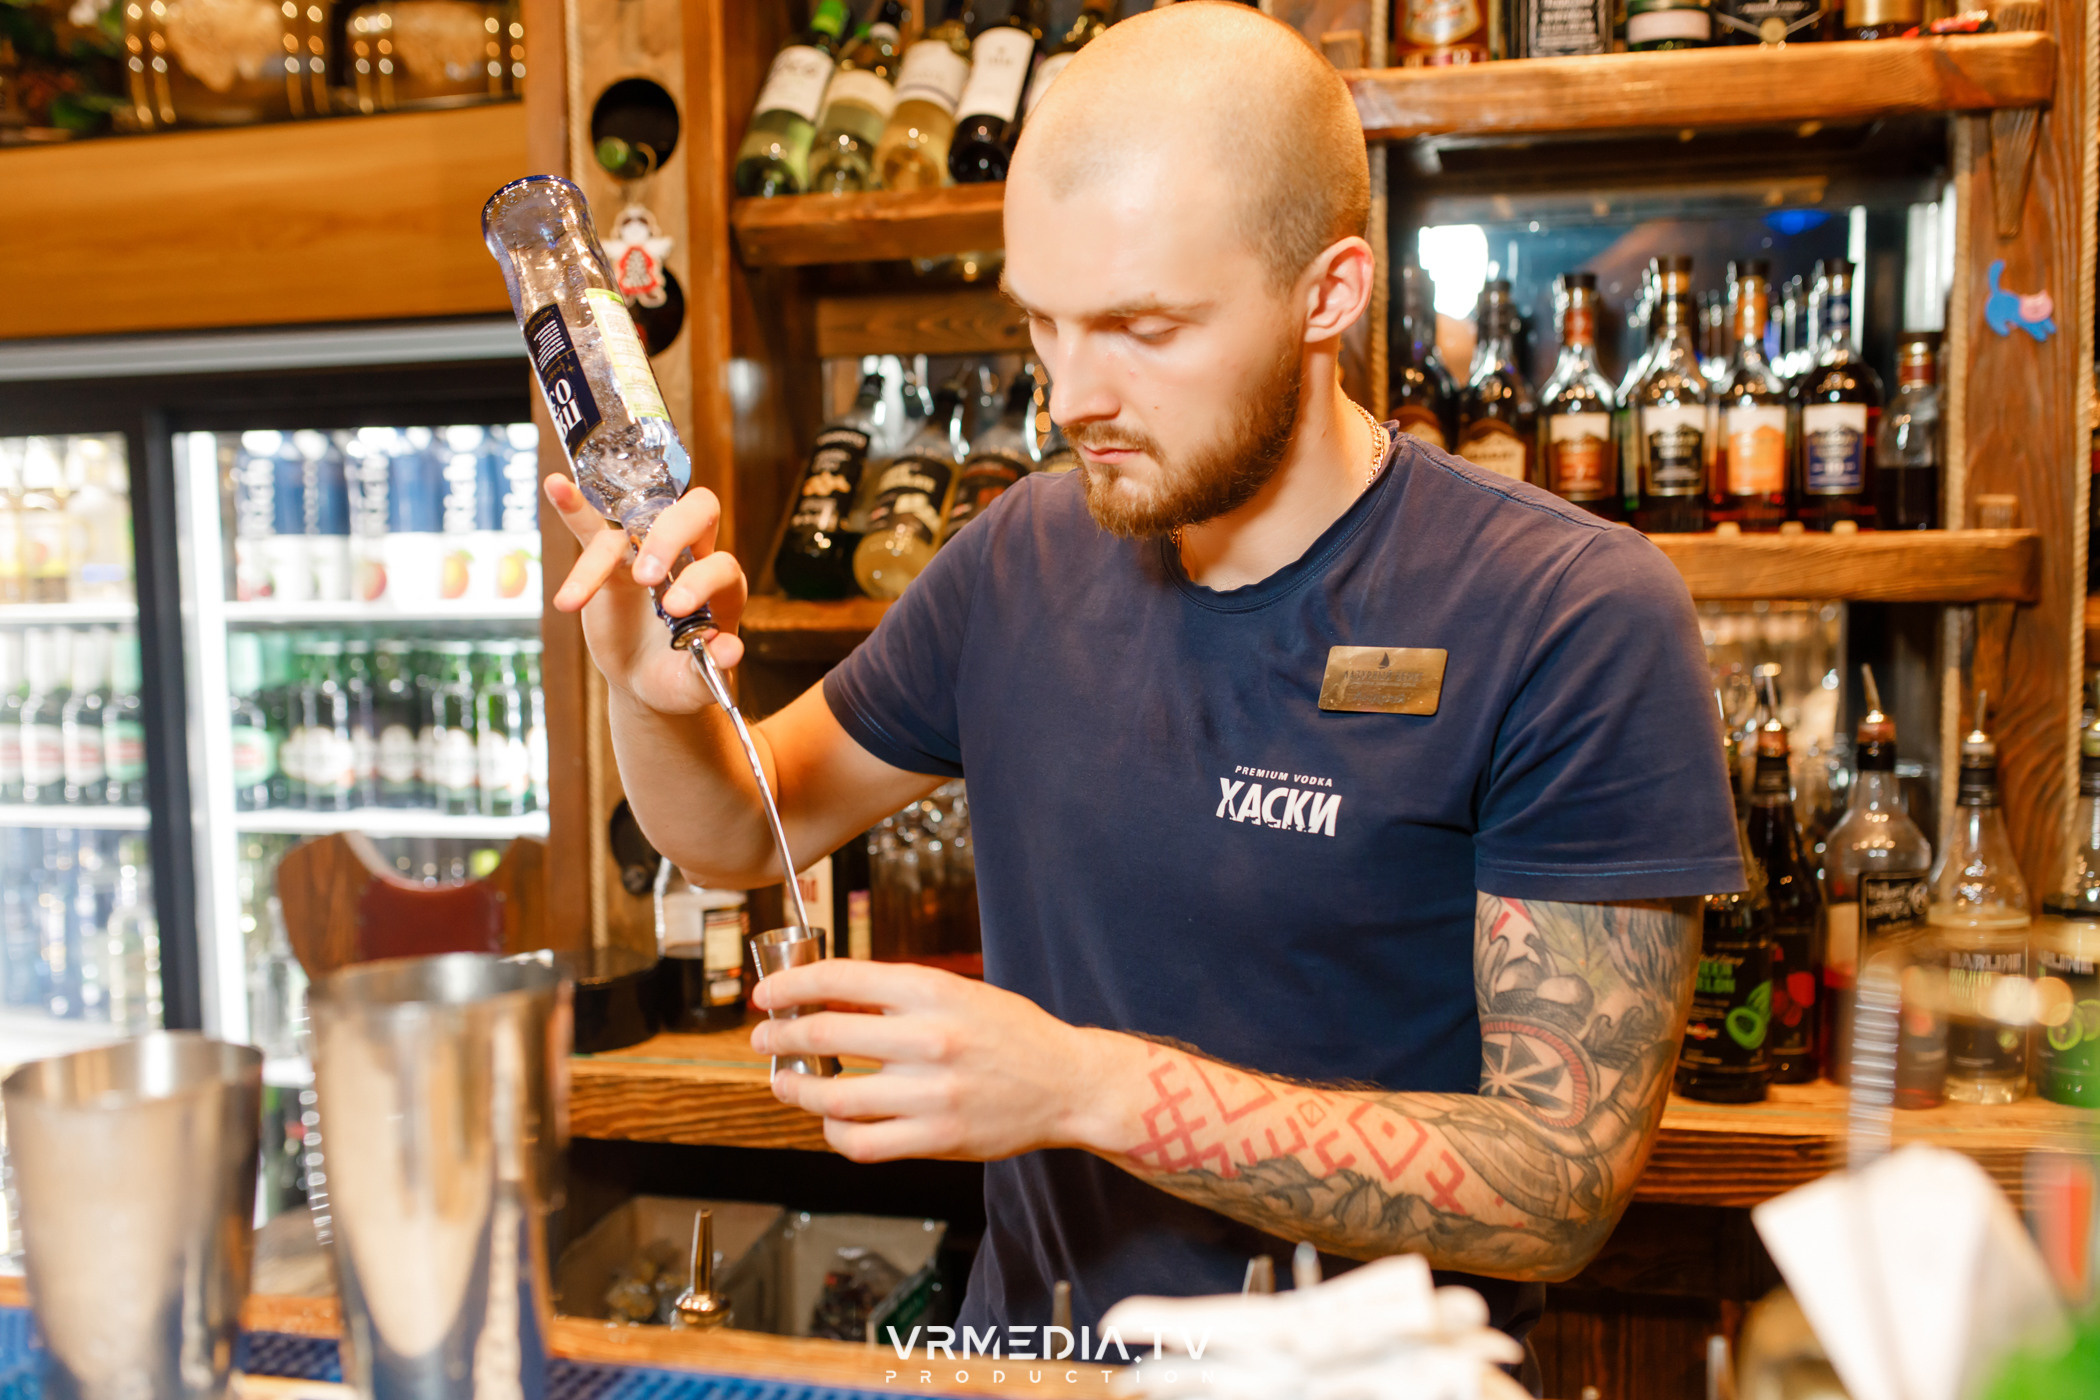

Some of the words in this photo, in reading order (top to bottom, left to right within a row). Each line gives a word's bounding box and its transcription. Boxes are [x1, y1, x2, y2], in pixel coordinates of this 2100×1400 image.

[1235, 765, 1289, 781] PREMIUM
[1293, 774, 1333, 787] VODKA
[1215, 777, 1342, 837] ХАСКИ
